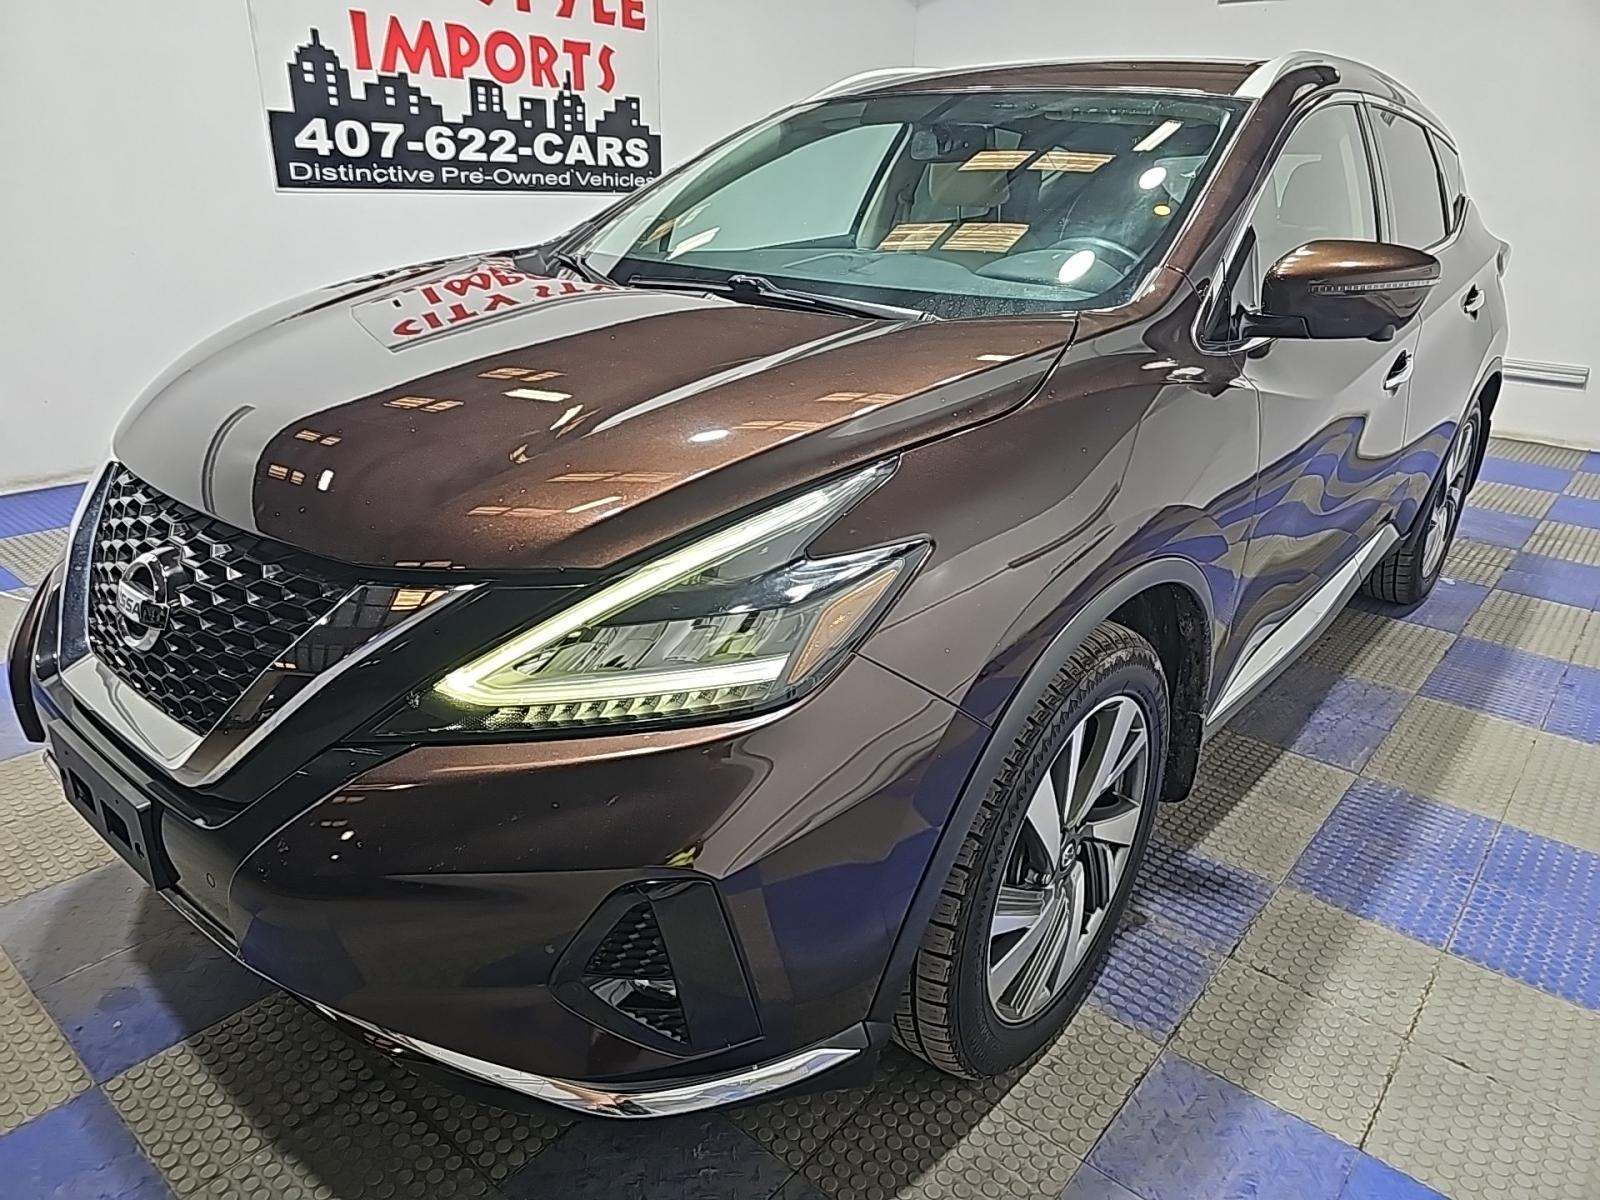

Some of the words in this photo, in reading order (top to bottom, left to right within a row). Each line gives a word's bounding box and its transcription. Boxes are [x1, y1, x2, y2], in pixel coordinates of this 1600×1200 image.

[349, 10, 615, 93] IMPORTS
[294, 118, 650, 169] 407-622-CARS
[289, 161, 435, 184] Distinctive
[442, 167, 571, 187] Pre-Owned
